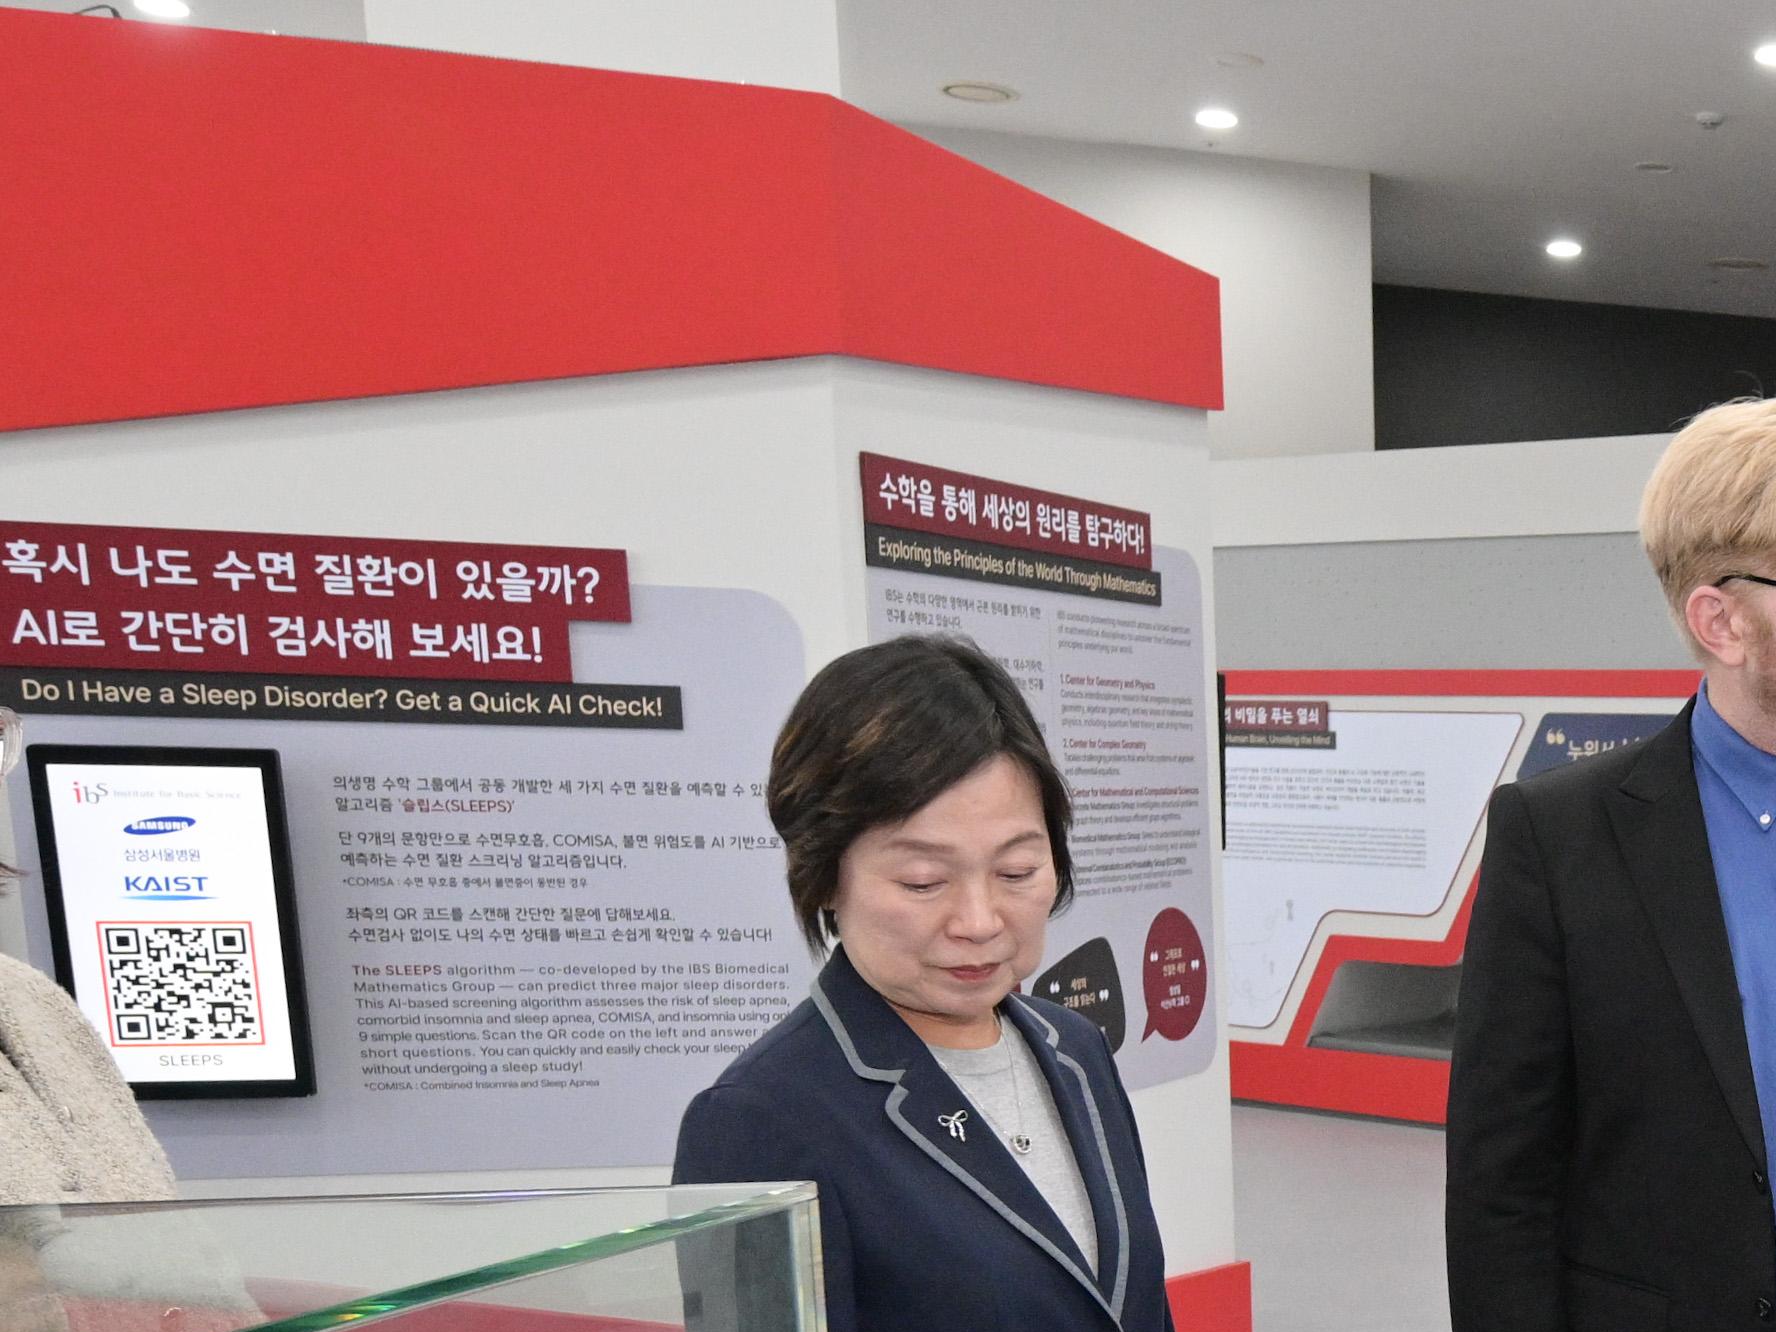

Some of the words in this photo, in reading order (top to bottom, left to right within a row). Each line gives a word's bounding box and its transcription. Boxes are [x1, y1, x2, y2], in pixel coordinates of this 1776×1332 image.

[879, 472, 935, 516] 수학을
[942, 484, 977, 525] 통해
[982, 496, 1031, 534] 세상의
[1037, 504, 1081, 544] 원리를
[1085, 512, 1145, 555] 탐구하다!
[2, 539, 90, 586] 혹시
[109, 544, 199, 588] 나도
[212, 548, 298, 594] 수면
[313, 553, 437, 601] 질환이
[456, 558, 601, 605] 있을까?
[878, 536, 931, 567] Exploring
[933, 546, 951, 565] the
[953, 548, 1003, 576] Principles
[1005, 557, 1017, 576] of
[1018, 558, 1034, 578] the
[1036, 561, 1063, 581] World
[1064, 566, 1101, 590] Through
[1102, 572, 1156, 597] Mathematics
[12, 608, 105, 648] AI로
[121, 611, 249, 656] 간단히
[268, 616, 394, 661] 검사해
[409, 620, 542, 664] 보세요!
[21, 678, 61, 701] Do
[67, 679, 75, 701] I
[82, 680, 152, 703] Have
[161, 687, 176, 704] a
[182, 681, 258, 711] Sleep
[264, 683, 388, 708] Disorder?
[396, 688, 440, 711] Get
[448, 694, 463, 712] a
[469, 689, 541, 714] Quick
[547, 693, 573, 714] AI
[578, 692, 662, 718] Check!
[333, 776, 376, 791] 의생명
[382, 777, 410, 791] 수학
[416, 777, 473, 792] 그룹에서
[478, 779, 506, 793] 공동
[512, 779, 553, 794] 개발한
[558, 779, 572, 794] 세
[577, 780, 604, 795] 가지
[609, 780, 637, 795] 수면
[642, 781, 682, 796] 질환을
[687, 782, 727, 797] 예측할
[732, 783, 745, 797] 수
[335, 797, 393, 812] 알고리즘
[129, 819, 191, 832] SAMSUNG
[338, 831, 351, 846] 단
[357, 831, 396, 846] 9개의
[401, 832, 471, 847] 문항만으로
[553, 834, 618, 848] COMISA,
[623, 835, 648, 849] 불면
[654, 835, 705, 849] 위험도를
[712, 836, 725, 848] AI
[730, 836, 782, 850] 기반으로
[124, 848, 200, 862] 삼성서울병원
[340, 853, 398, 868] 예측하는
[402, 853, 430, 867] 수면
[435, 853, 463, 868] 질환
[468, 853, 523, 868] 스크리닝
[528, 854, 627, 869] 알고리즘입니다.
[124, 876, 209, 892] KAIST
[346, 907, 389, 921] 좌측의
[394, 908, 417, 921] QR
[422, 907, 463, 921] 코드를
[469, 907, 510, 921] 스캔해
[515, 907, 555, 921] 간단한
[560, 907, 601, 921] 질문에
[606, 907, 676, 922] 답해보세요.
[348, 928, 404, 942] 수면검사
[410, 928, 452, 942] 없이도
[456, 928, 484, 942] 나의
[489, 928, 515, 942] 수면
[521, 928, 561, 942] 상태를
[565, 928, 607, 942] 빠르고
[611, 928, 651, 942] 손쉽게
[655, 928, 694, 942] 확인할
[699, 928, 712, 942] 수
[717, 928, 773, 942] 있습니다!
[352, 964, 381, 976] The
[385, 964, 442, 976] SLEEPS
[446, 963, 515, 978] algorithm
[539, 963, 636, 977] co-developed
[641, 963, 657, 976] by
[662, 963, 684, 974] the
[688, 963, 711, 974] IBS
[715, 962, 789, 975] Biomedical
[353, 981, 447, 993] Mathematics
[452, 981, 496, 995] Group
[518, 983, 543, 992] can
[547, 980, 596, 994] predict
[601, 980, 636, 991] three
[641, 980, 678, 993] major
[683, 979, 719, 993] sleep
[723, 978, 789, 991] disorders.
[355, 998, 384, 1009] This
[388, 997, 448, 1009] AI-based
[452, 997, 517, 1011] screening
[520, 996, 581, 1010] algorithm
[585, 997, 644, 1007] assesses
[649, 996, 668, 1006] the
[671, 995, 694, 1006] risk
[696, 995, 710, 1006] of
[712, 995, 746, 1008] sleep
[749, 997, 790, 1008] apnea,
[357, 1014, 421, 1026] comorbid
[424, 1013, 483, 1025] insomnia
[486, 1013, 511, 1025] and
[514, 1012, 549, 1026] sleep
[552, 1015, 596, 1026] apnea,
[598, 1012, 655, 1025] COMISA,
[657, 1012, 680, 1023] and
[683, 1011, 736, 1022] insomnia
[738, 1011, 770, 1024] using
[358, 1031, 368, 1042] 9
[371, 1030, 412, 1044] simple
[415, 1030, 480, 1043] questions.
[482, 1029, 516, 1040] Scan
[521, 1029, 542, 1040] the
[547, 1029, 567, 1040] QR
[571, 1028, 605, 1039] code
[609, 1030, 626, 1039] on
[630, 1028, 651, 1038] the
[655, 1027, 677, 1038] left
[681, 1027, 706, 1038] and
[710, 1028, 757, 1037] answer
[360, 1047, 398, 1059] short
[402, 1046, 476, 1060] questions.
[480, 1046, 504, 1057] You
[506, 1048, 530, 1057] can
[533, 1045, 577, 1059] quickly
[580, 1044, 604, 1055] and
[606, 1044, 641, 1057] easily
[644, 1043, 680, 1054] check
[683, 1045, 710, 1056] your
[159, 1054, 223, 1067] SLEEPS
[361, 1063, 411, 1075] without
[415, 1062, 487, 1076] undergoing
[490, 1064, 498, 1073] a
[502, 1061, 538, 1074] sleep
[542, 1060, 583, 1074] study!
